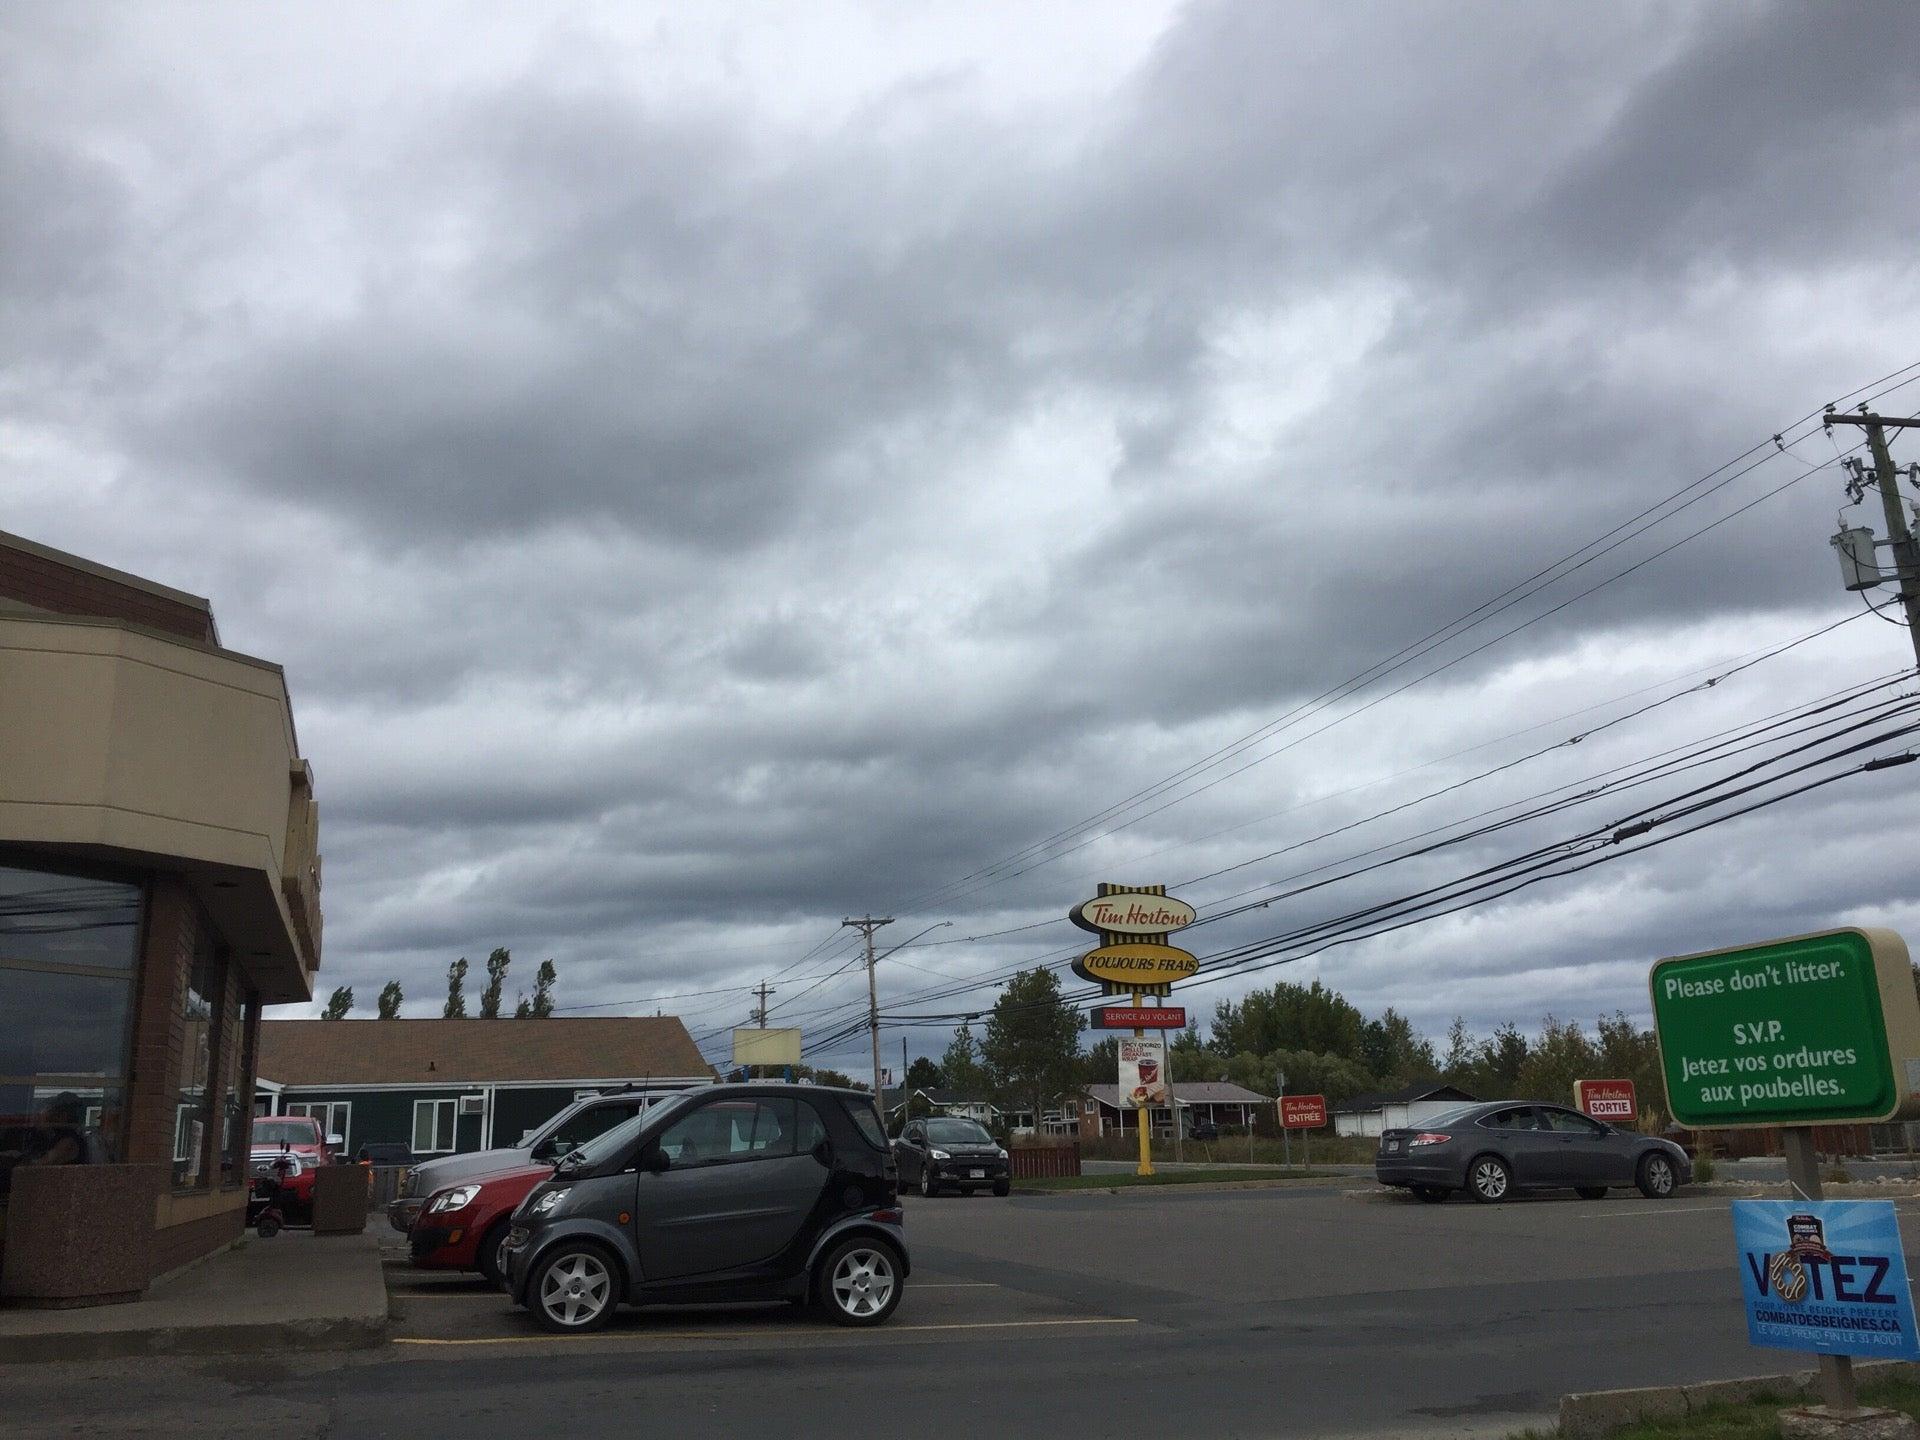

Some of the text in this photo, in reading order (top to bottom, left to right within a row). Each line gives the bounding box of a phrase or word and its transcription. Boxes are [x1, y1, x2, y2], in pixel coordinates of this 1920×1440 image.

[1092, 903, 1188, 926] Tim Hortons
[1088, 956, 1196, 972] TOUJOURS FRAIS
[1664, 960, 1845, 1000] Please don't litter.
[1105, 1012, 1183, 1021] SERVICE AU VOLANT
[1732, 1020, 1785, 1046] S.V.P.
[1681, 1045, 1857, 1083] Jetez vos ordures
[1586, 1088, 1631, 1100] Tim Hortons
[1700, 1074, 1846, 1107] aux poubelles.
[1285, 1101, 1322, 1111] Tim Hortons
[1591, 1102, 1628, 1113] SORTIE
[1288, 1110, 1321, 1123] ENTRÉE
[1809, 1305, 1845, 1316] BEIGNE
[1756, 1309, 1902, 1333] COMBATDESBEIGNES.CA
[1758, 1325, 1768, 1335] LE
[1770, 1326, 1790, 1337] VOTE
[1792, 1328, 1822, 1340] PREND
[1824, 1330, 1841, 1342] FIN
[1843, 1333, 1856, 1343] LE
[1859, 1334, 1870, 1344] 31
